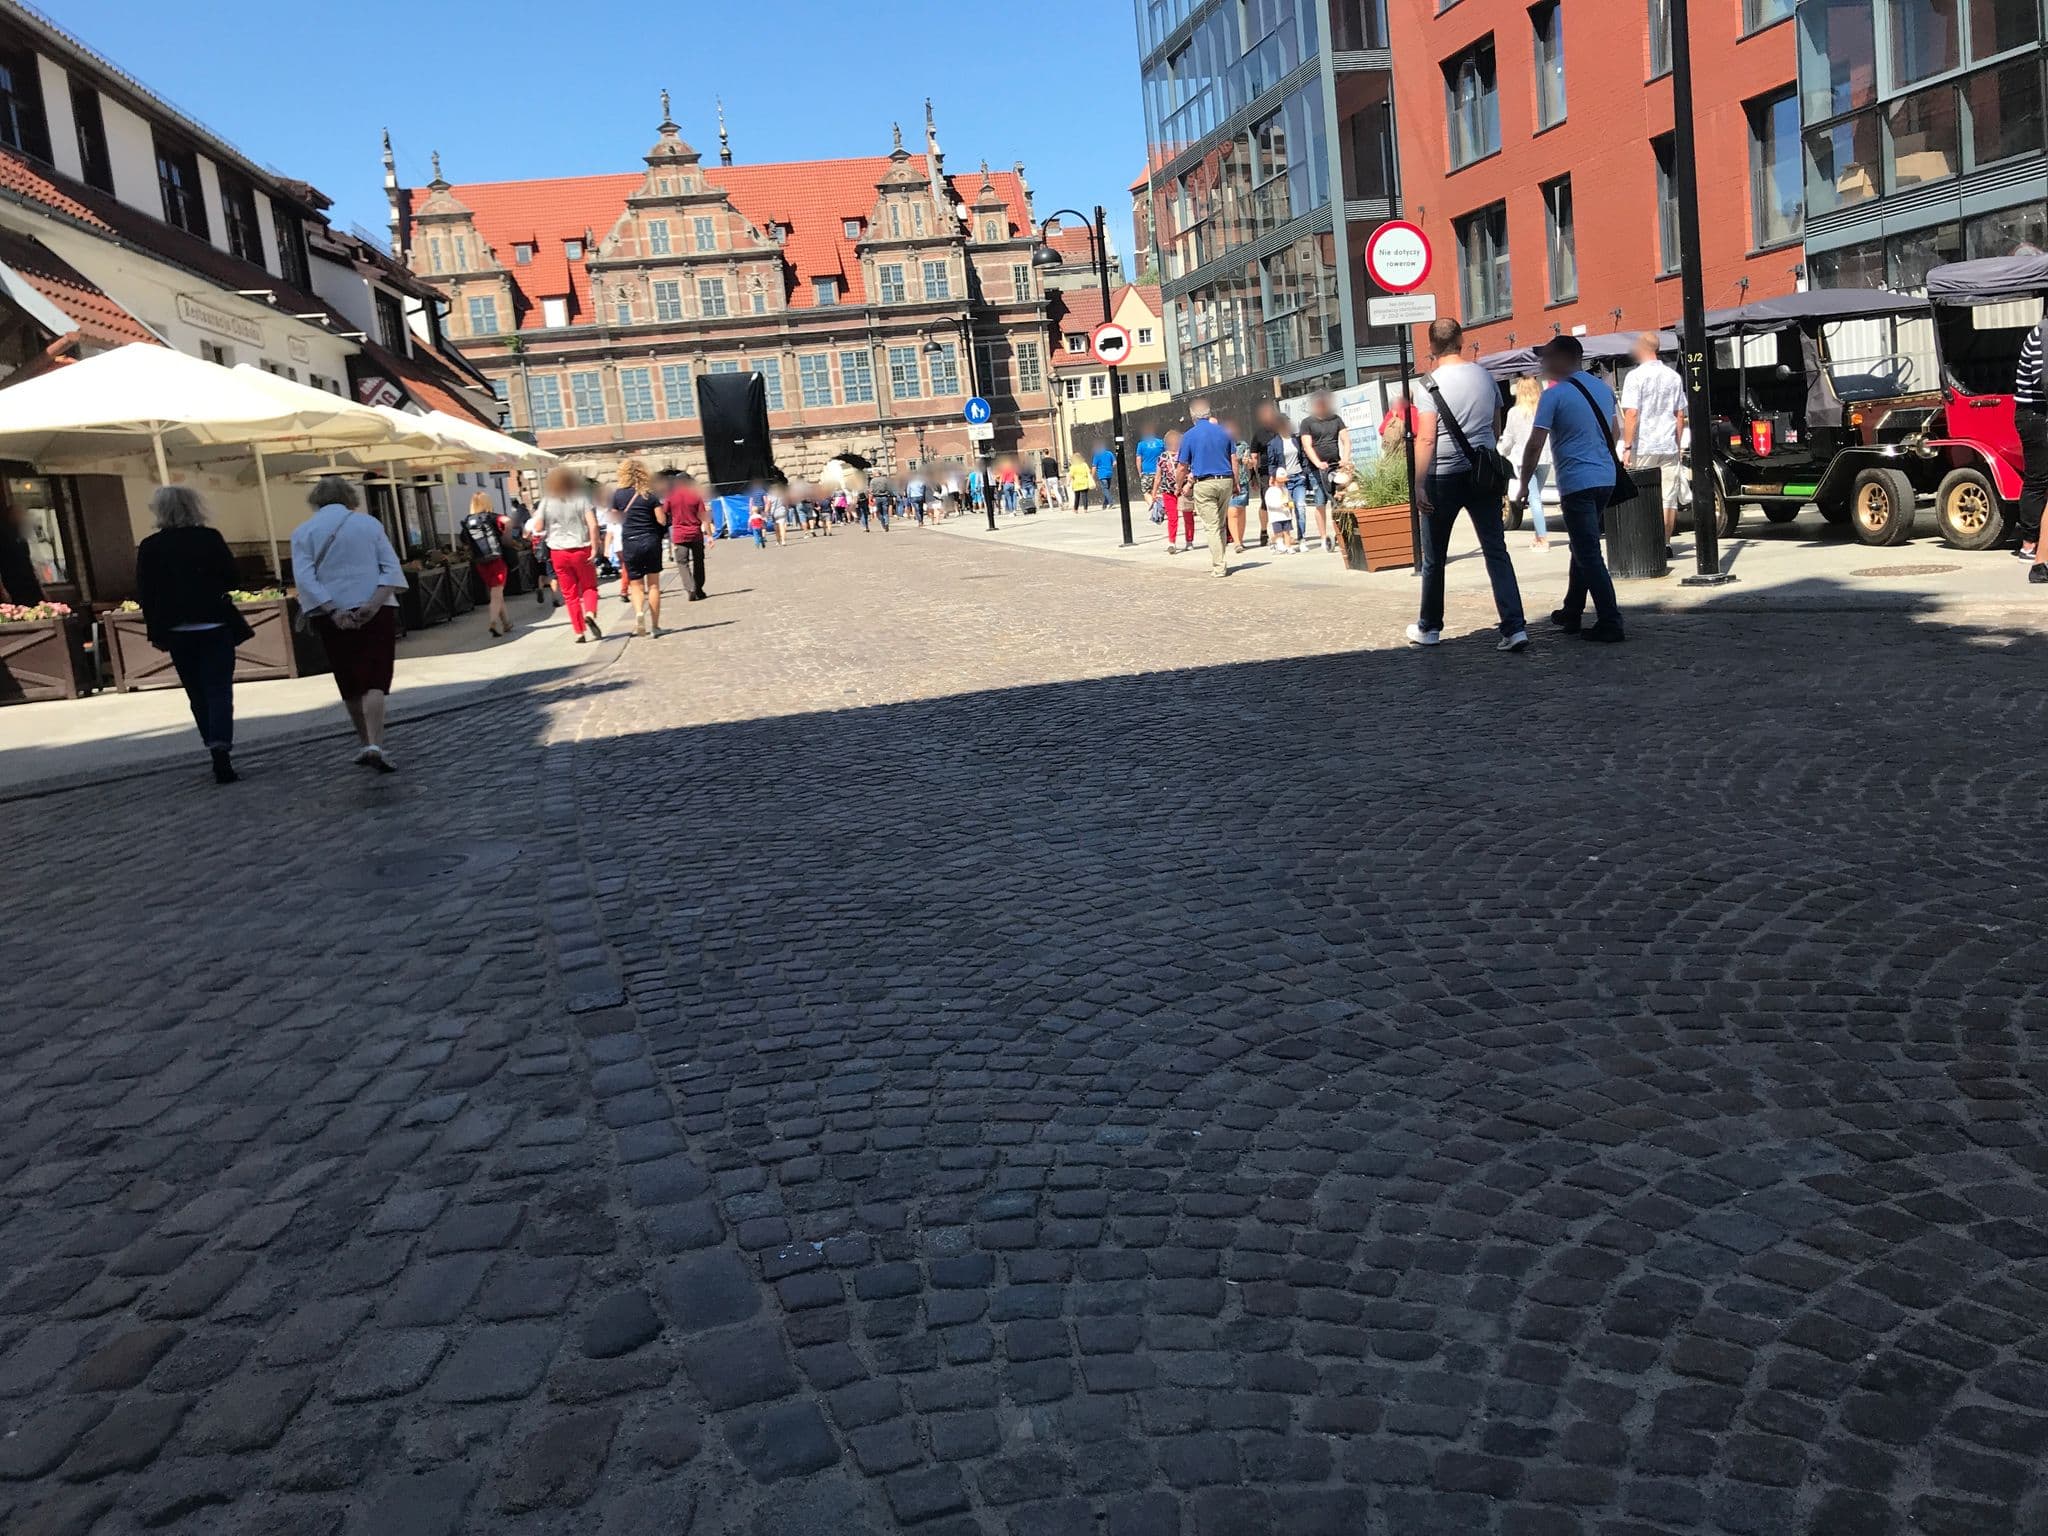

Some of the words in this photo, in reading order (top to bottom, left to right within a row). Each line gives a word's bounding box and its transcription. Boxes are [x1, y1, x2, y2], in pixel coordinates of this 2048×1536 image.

[1393, 249, 1420, 257] dotyczy
[1687, 352, 1703, 363] 3/2
[1691, 367, 1700, 376] T
